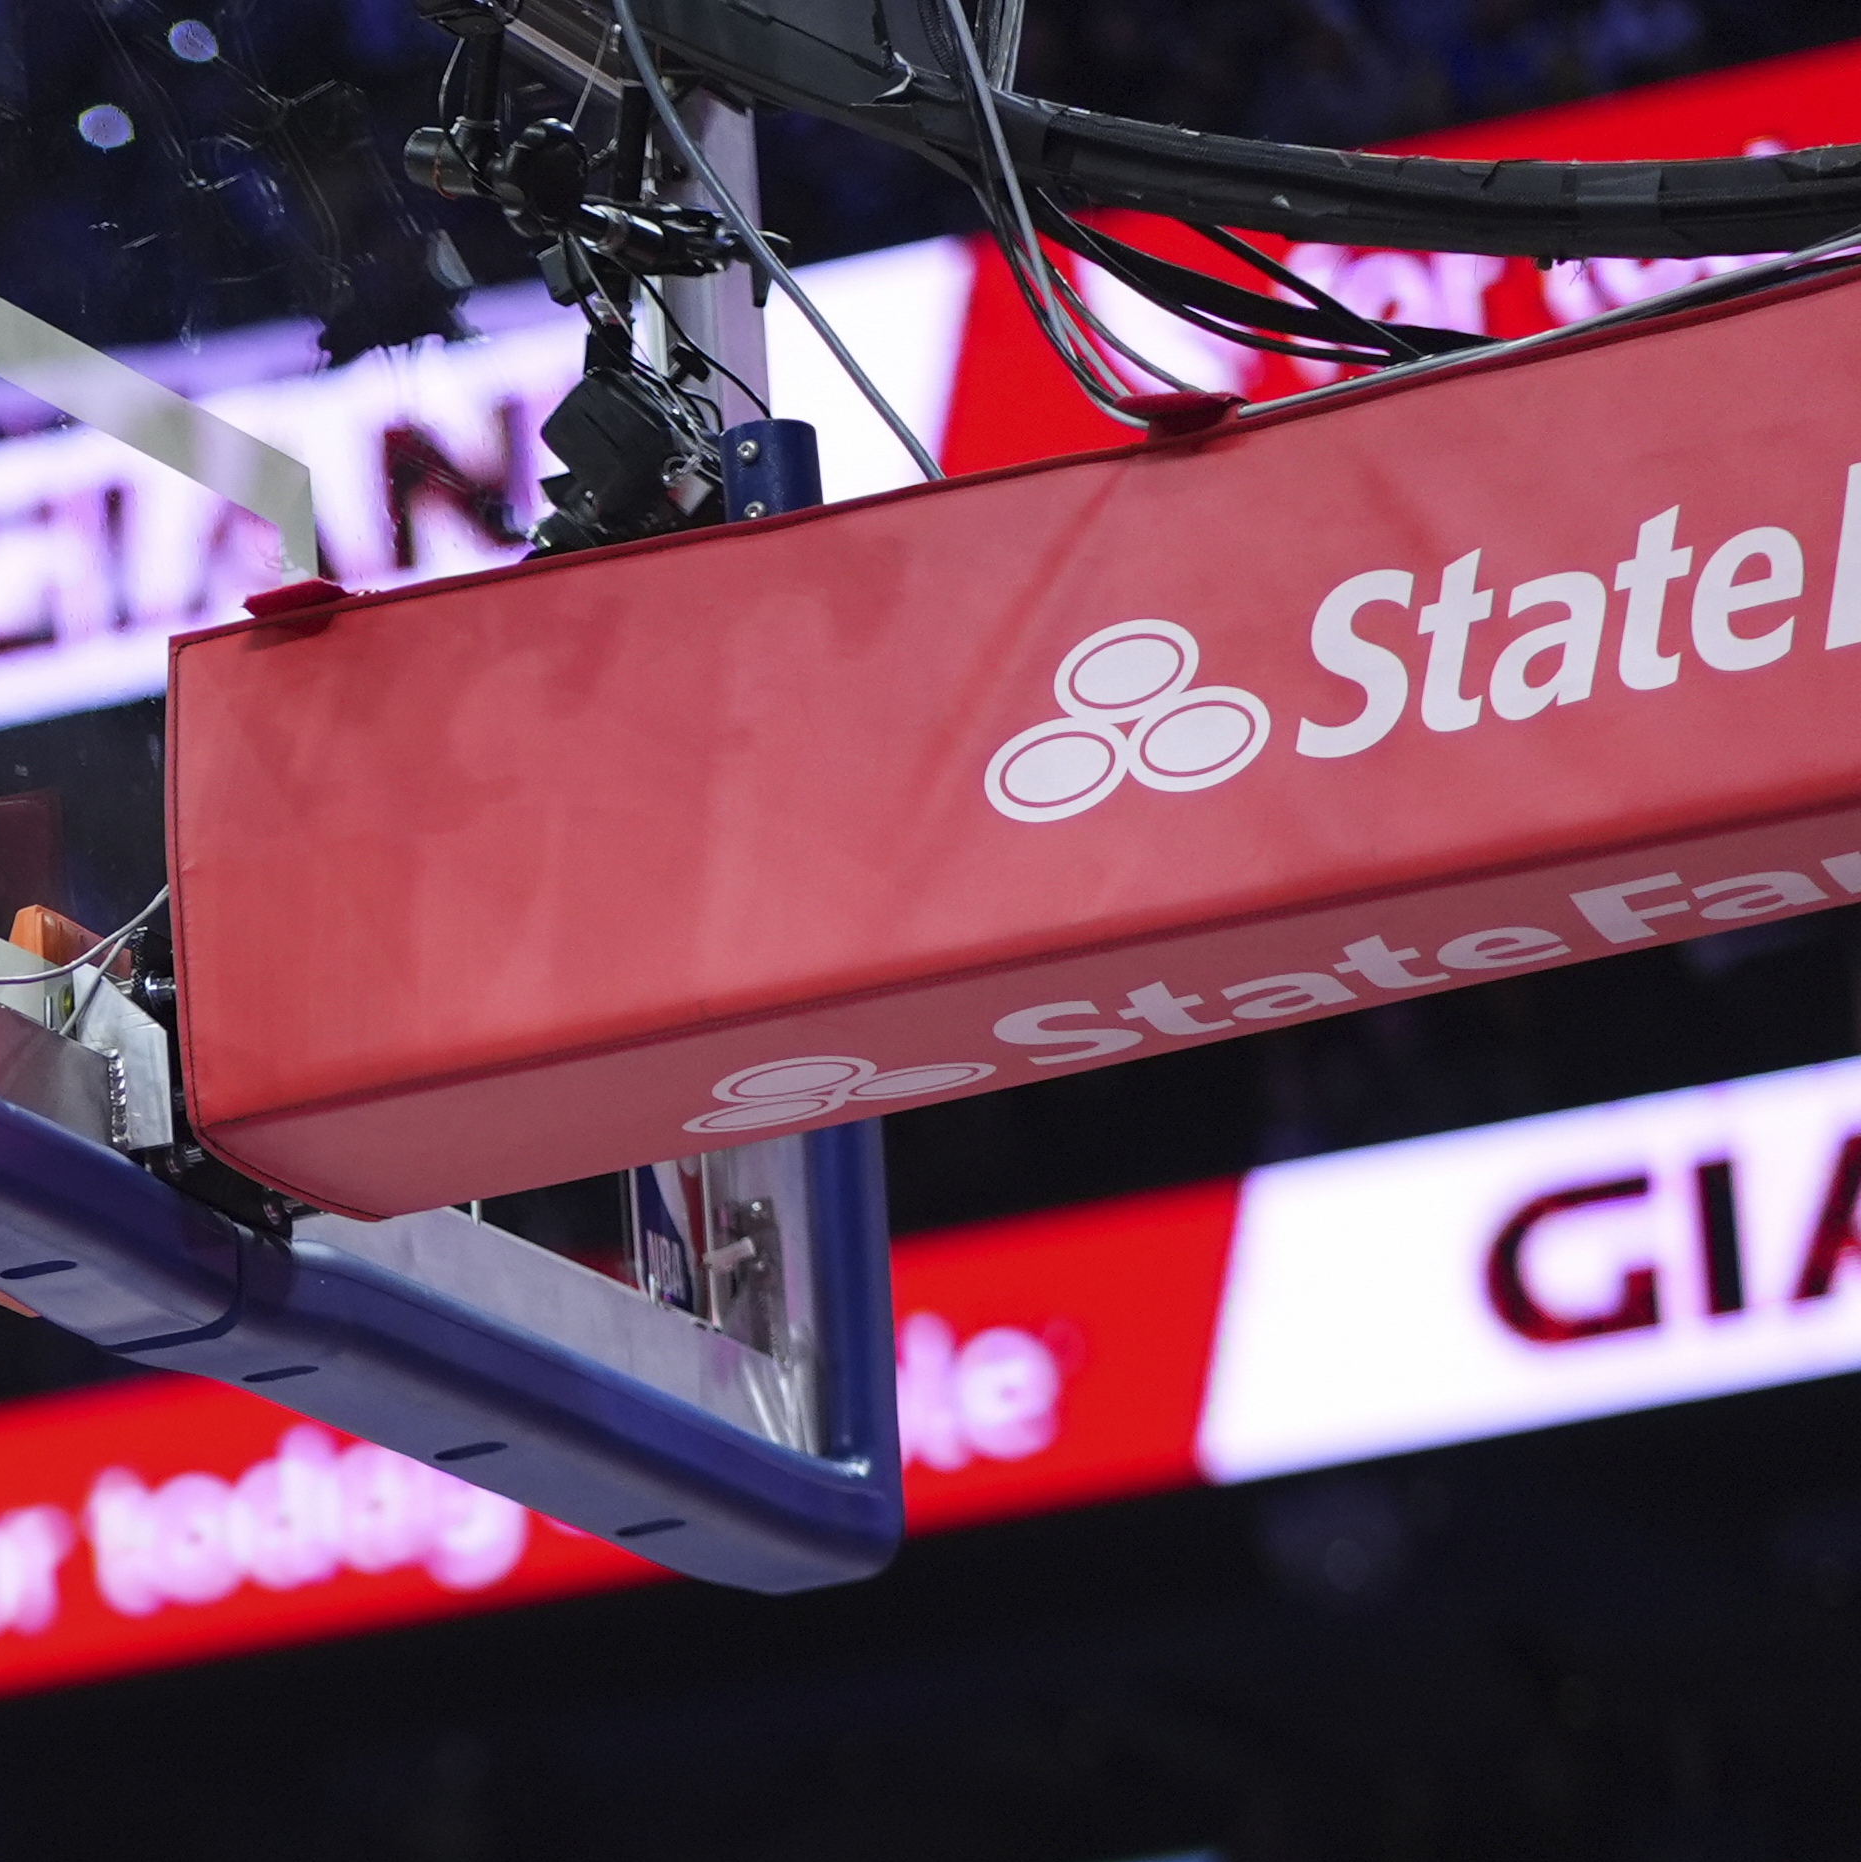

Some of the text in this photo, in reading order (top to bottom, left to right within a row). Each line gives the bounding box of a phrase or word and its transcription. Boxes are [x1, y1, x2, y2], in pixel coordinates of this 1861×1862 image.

[1295, 504, 1804, 759] State
[992, 934, 1571, 1065] State
[84, 1424, 535, 1618] today
